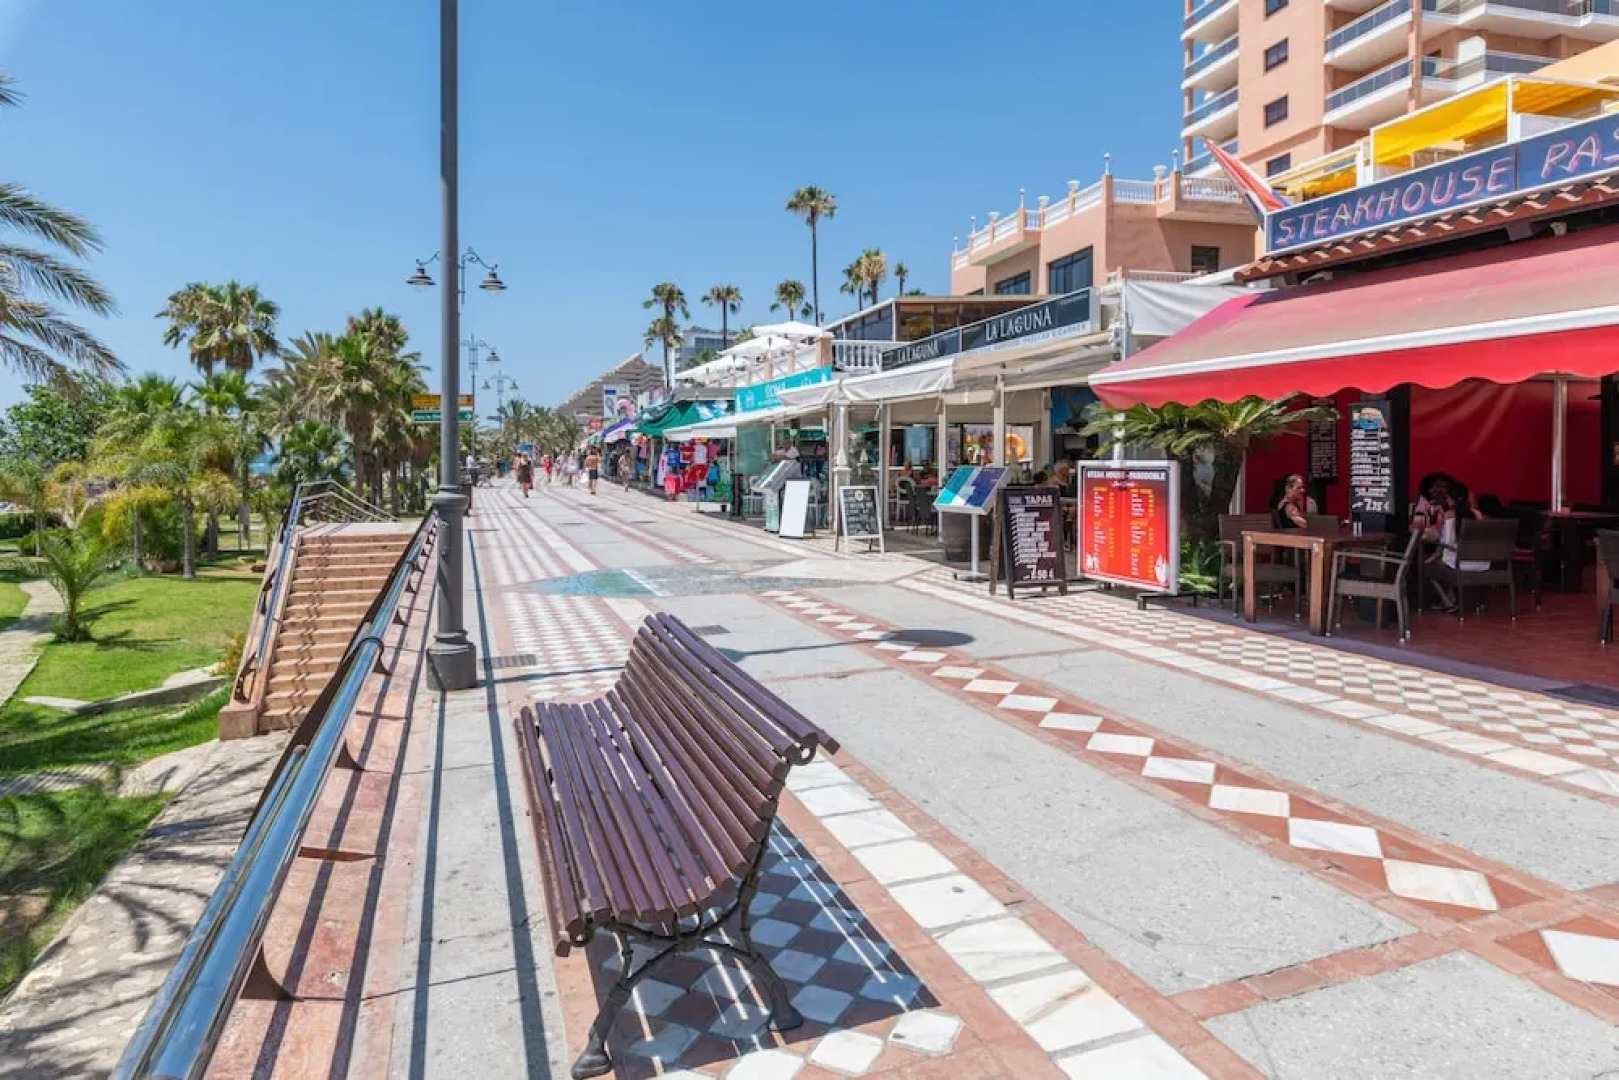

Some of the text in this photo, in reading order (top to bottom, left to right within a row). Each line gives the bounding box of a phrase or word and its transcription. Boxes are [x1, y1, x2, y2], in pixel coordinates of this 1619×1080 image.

[1275, 155, 1515, 248] STEAKHOUSE
[985, 306, 1052, 341] LA LAGUNA
[907, 339, 939, 361] LAGUNA
[1025, 494, 1053, 505] TAPAS
